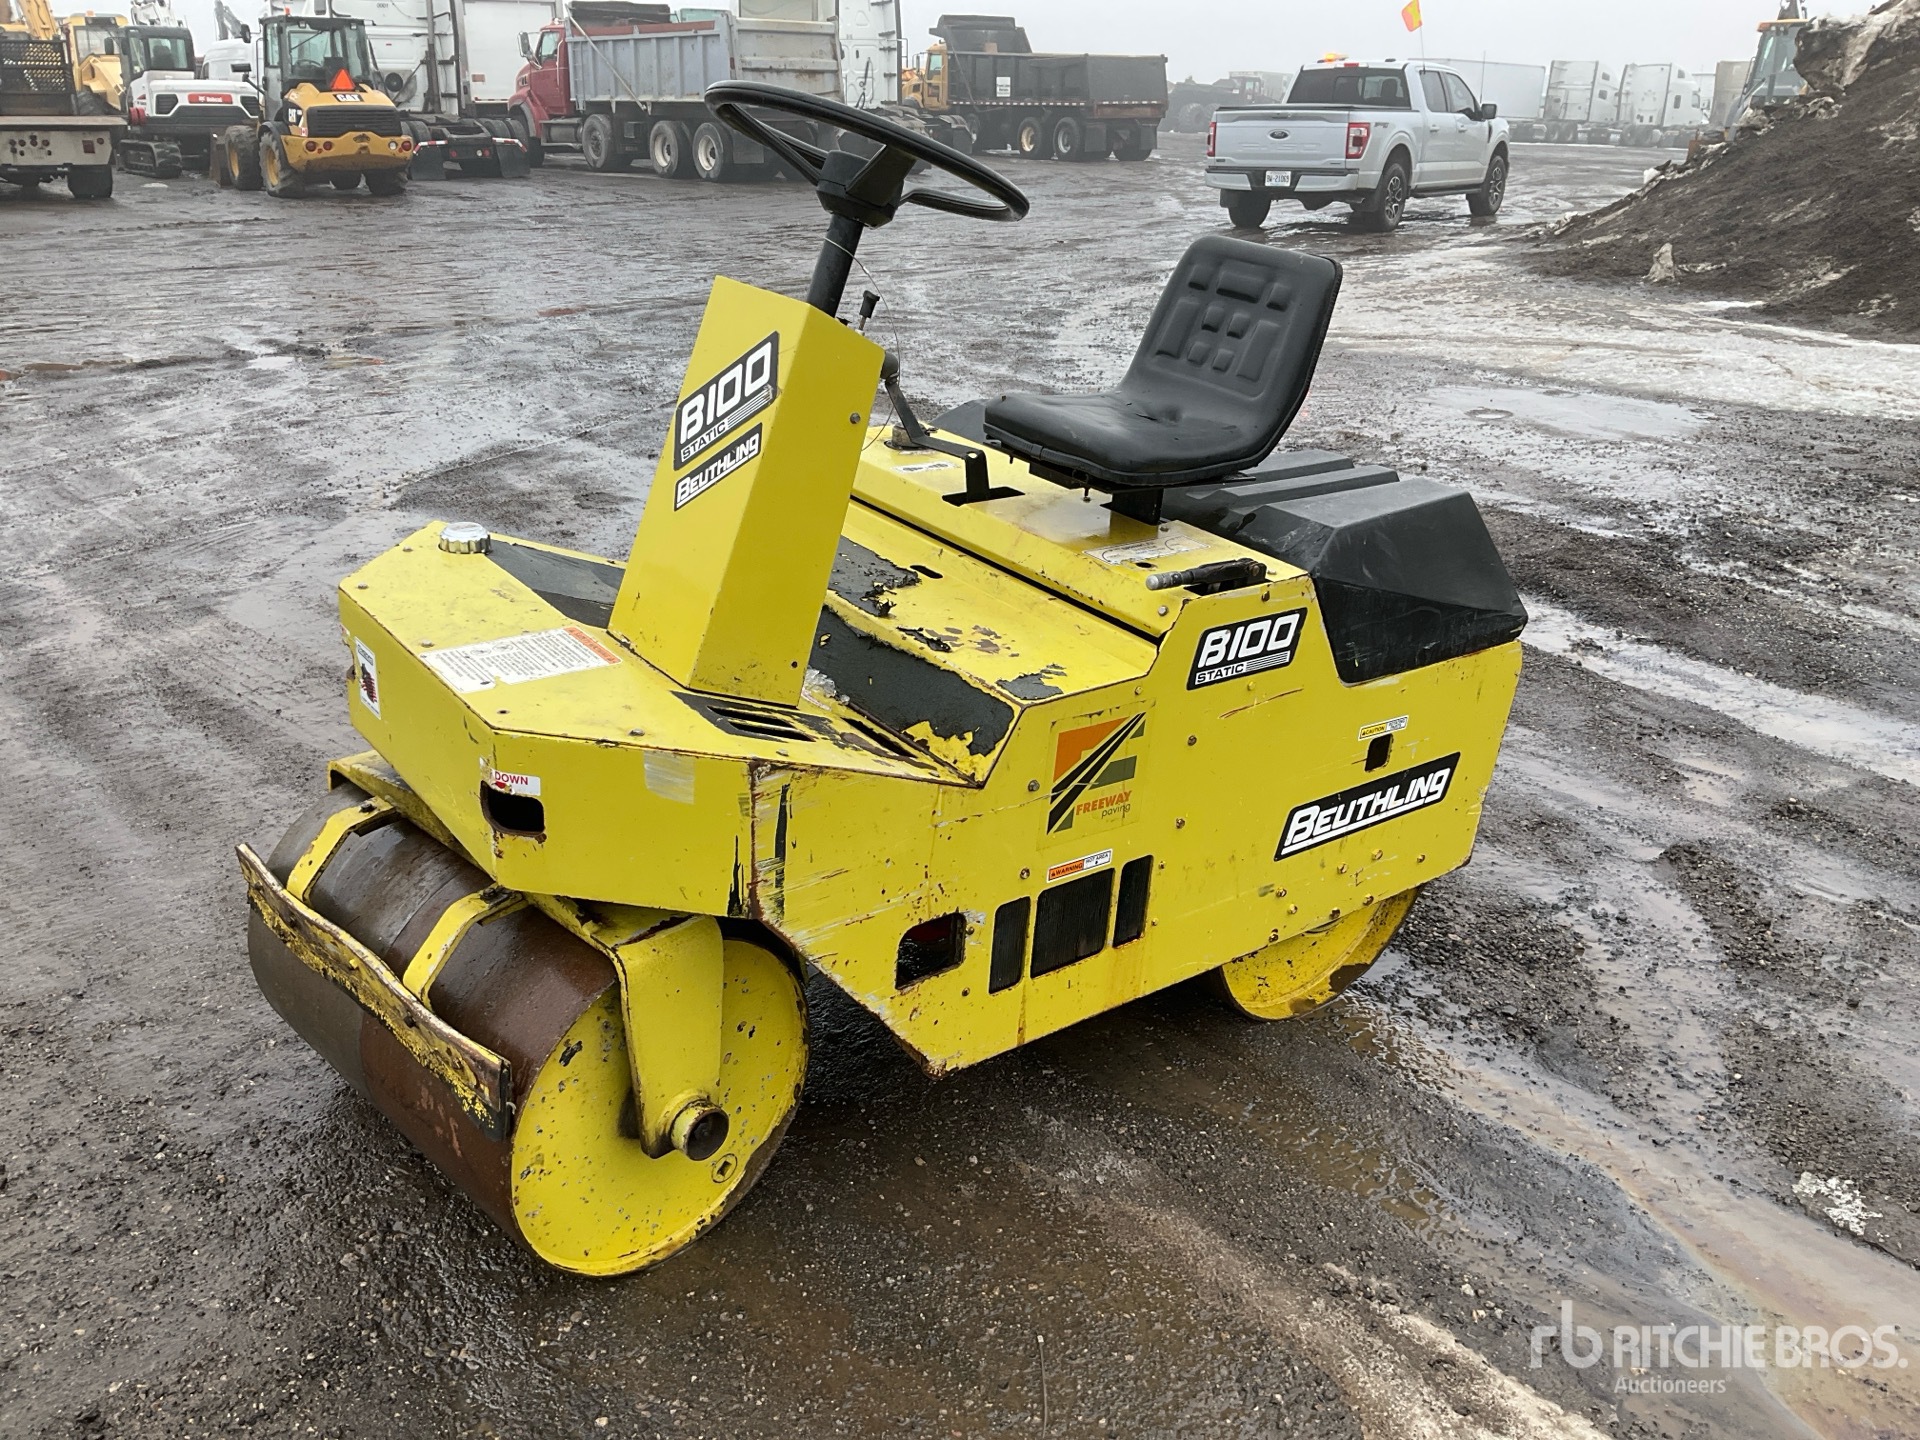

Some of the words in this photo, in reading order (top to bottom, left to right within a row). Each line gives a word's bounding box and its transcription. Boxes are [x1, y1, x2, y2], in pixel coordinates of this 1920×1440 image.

[336, 94, 361, 102] CAT
[679, 341, 772, 445] B100
[682, 421, 727, 460] STATIC
[1197, 613, 1301, 669] B100
[1197, 663, 1245, 683] STATIC
[1364, 726, 1385, 735] CAUTION
[494, 770, 529, 786] DOWN
[1075, 790, 1133, 816] FREEWAY
[1101, 803, 1131, 819] paving
[1055, 863, 1083, 876] WARNING
